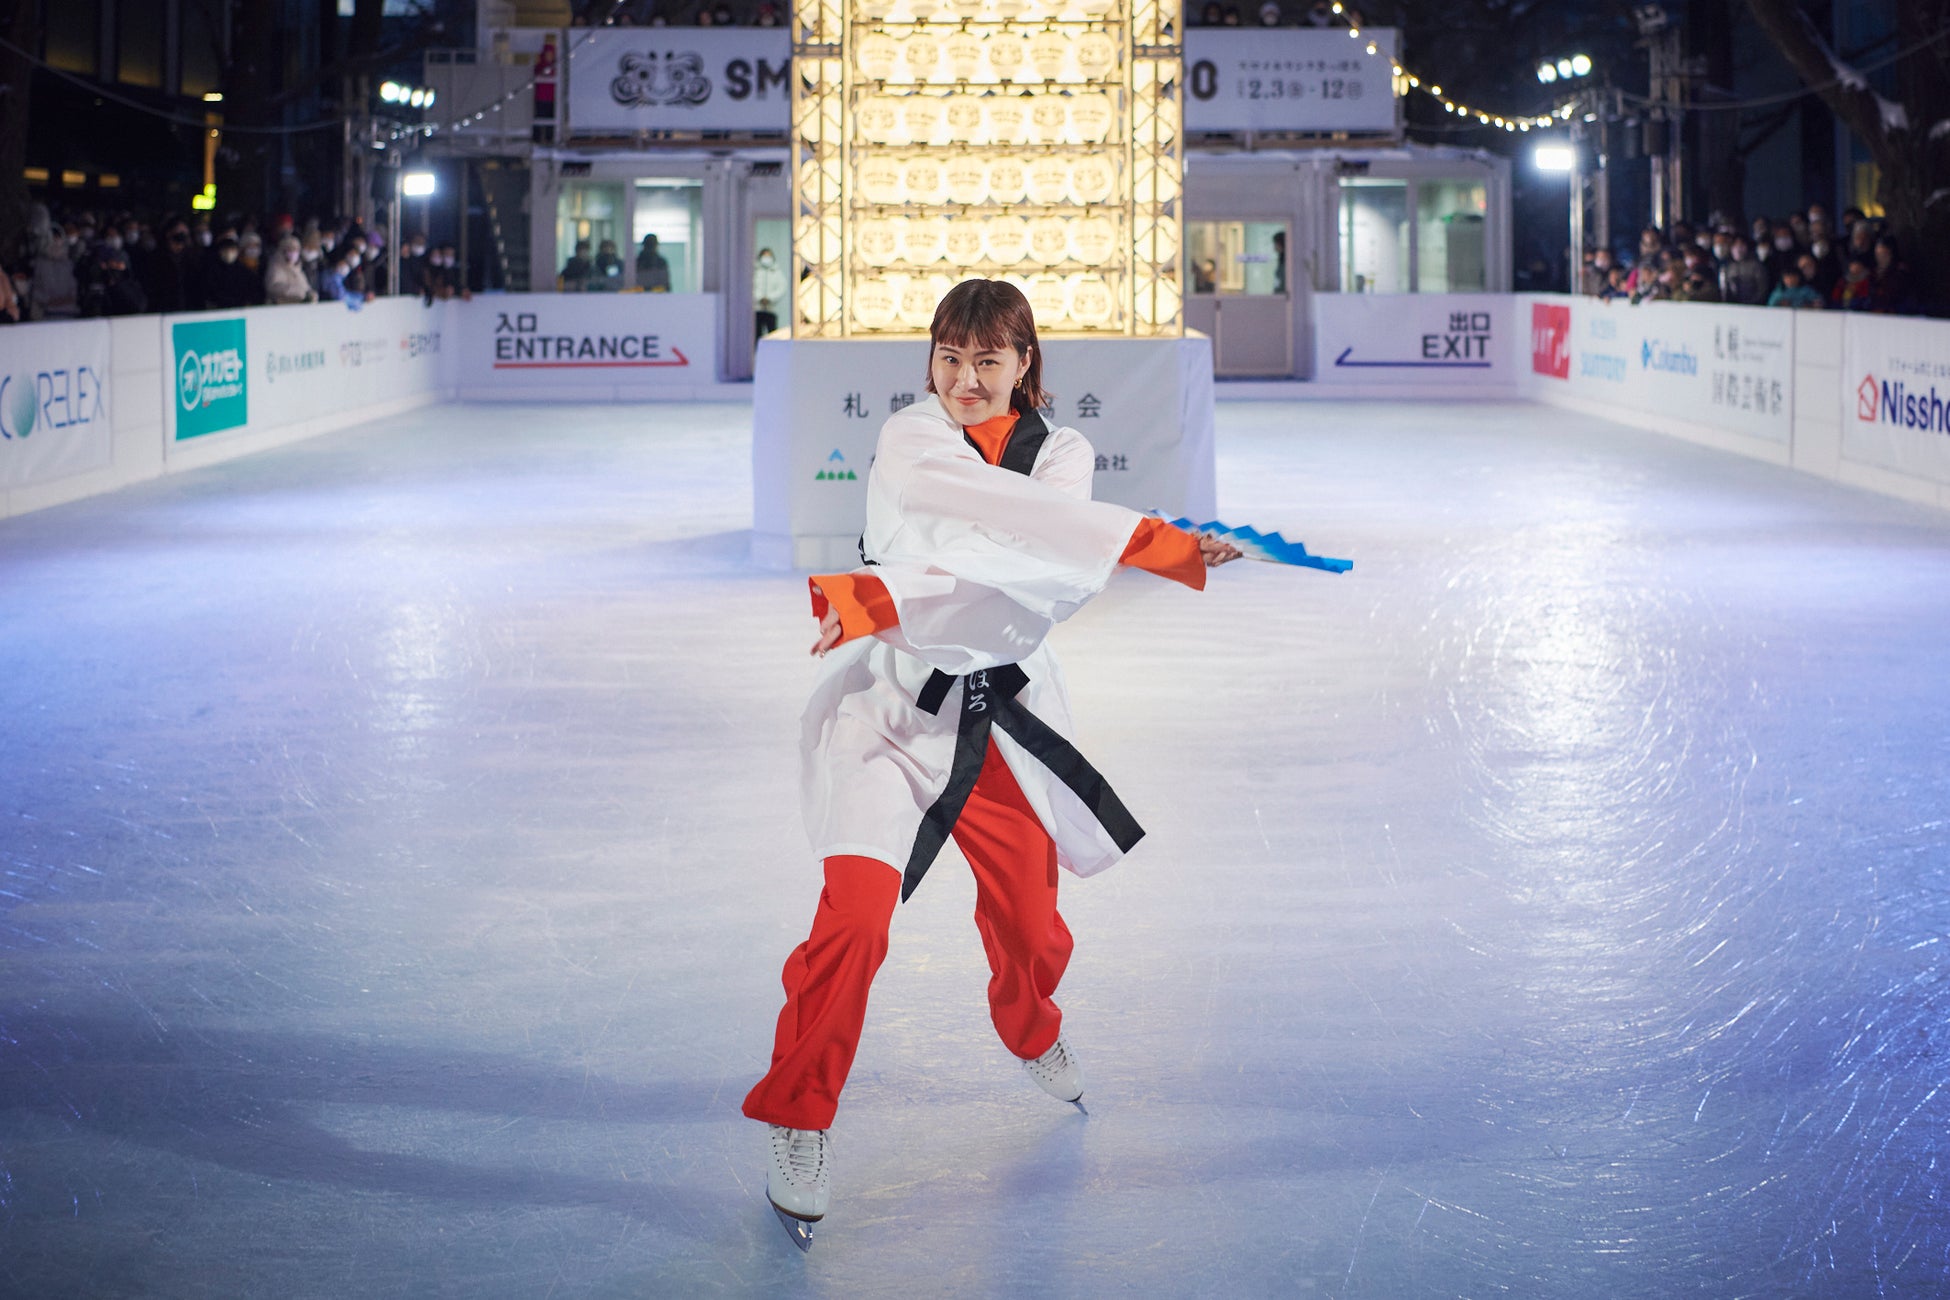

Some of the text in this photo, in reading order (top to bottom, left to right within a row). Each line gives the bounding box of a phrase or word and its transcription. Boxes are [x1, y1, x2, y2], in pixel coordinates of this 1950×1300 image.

[495, 313, 537, 333] 入口
[1449, 311, 1490, 332] 出口
[496, 336, 660, 360] ENTRANCE
[1422, 335, 1491, 358] EXIT
